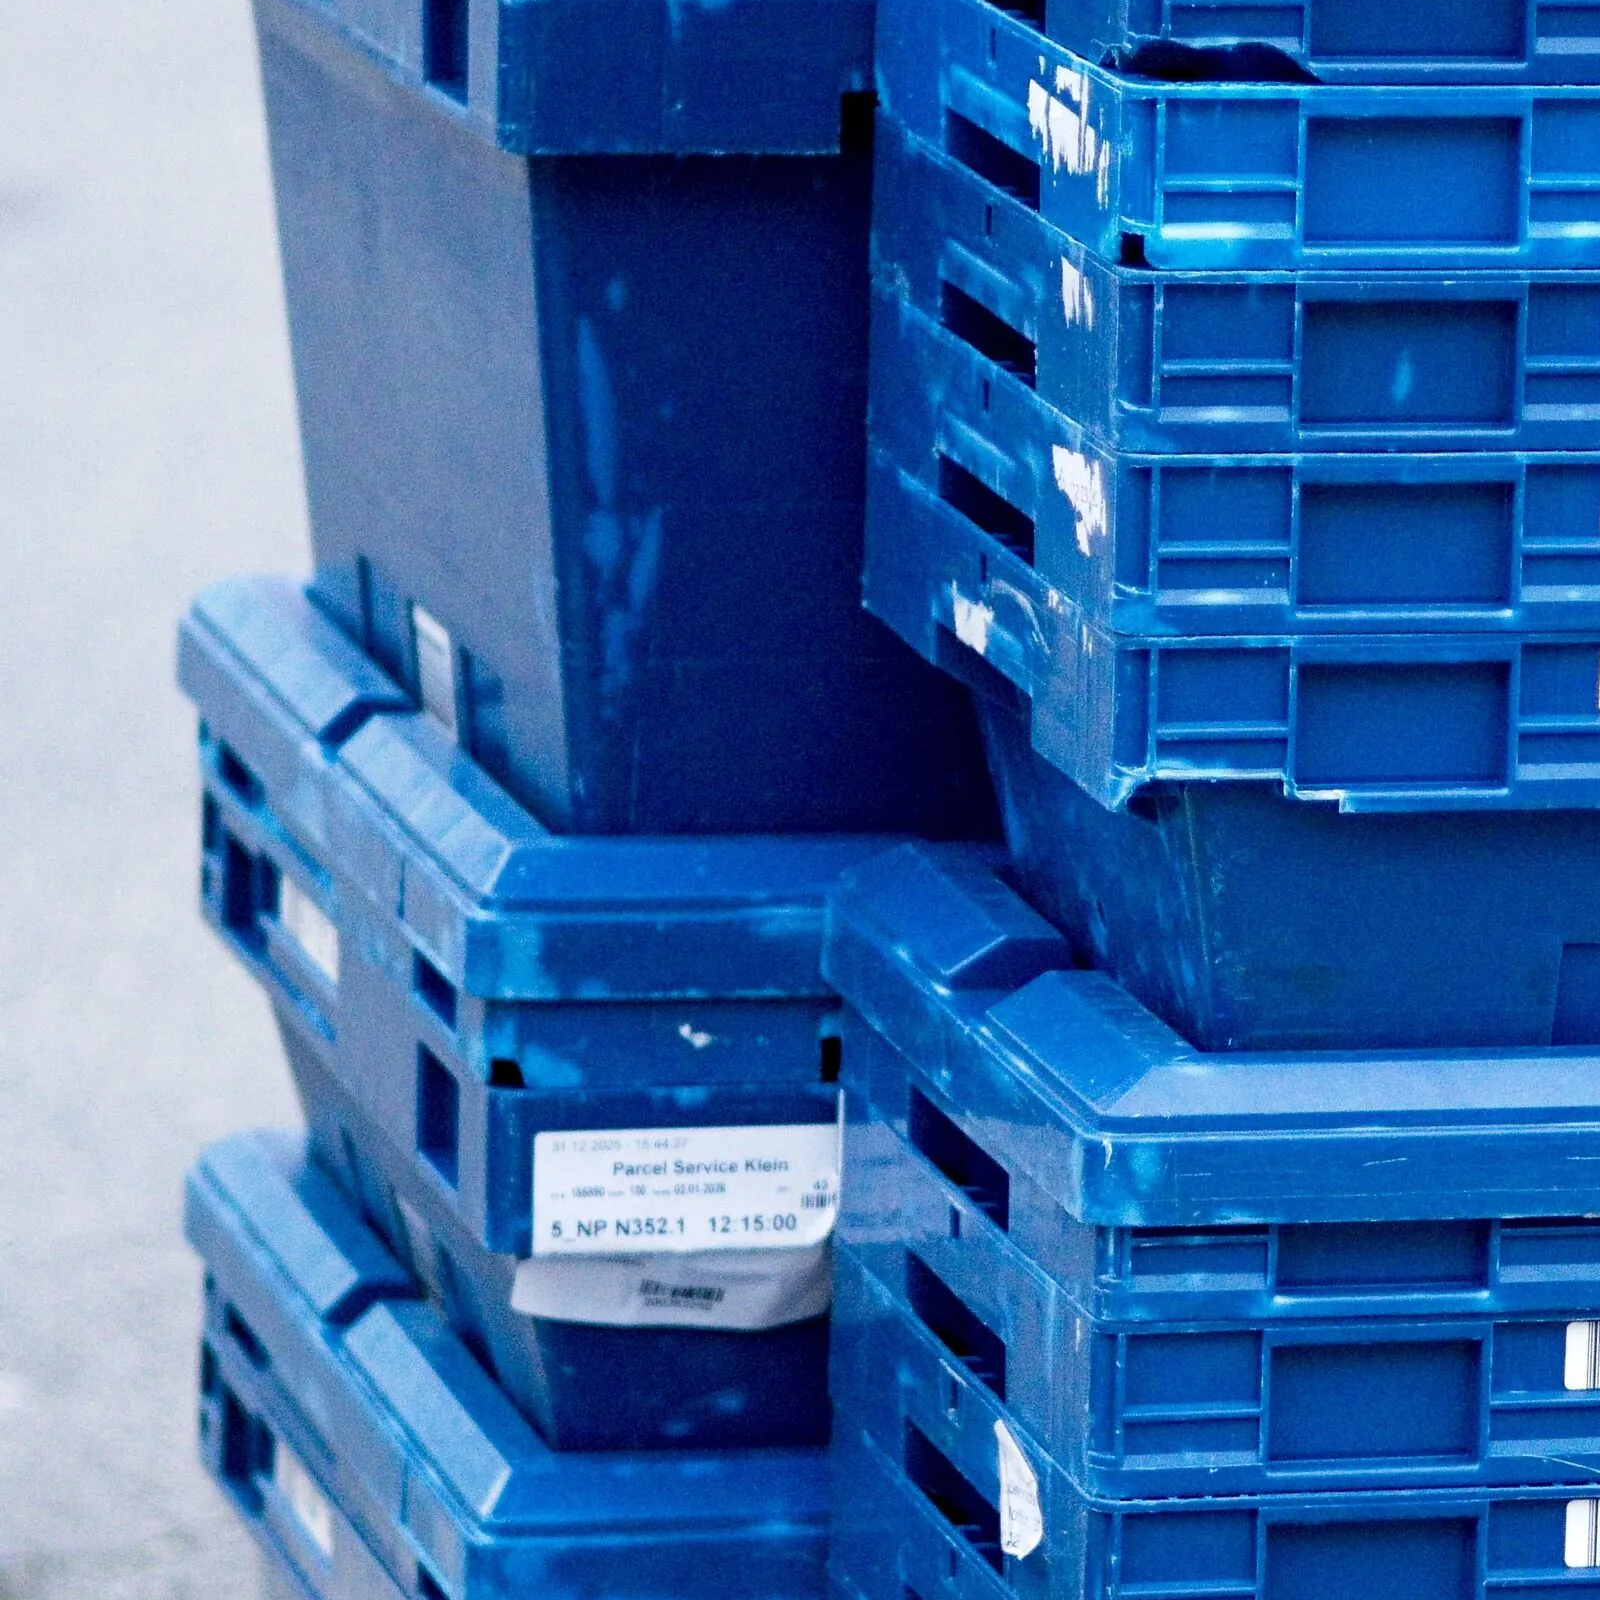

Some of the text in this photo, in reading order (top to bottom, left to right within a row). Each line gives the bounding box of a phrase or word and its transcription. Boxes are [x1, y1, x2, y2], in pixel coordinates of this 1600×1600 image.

[613, 1157, 789, 1176] Parcel Service Klein
[615, 1216, 686, 1236] N352.1
[708, 1213, 798, 1233] 12:15:00
